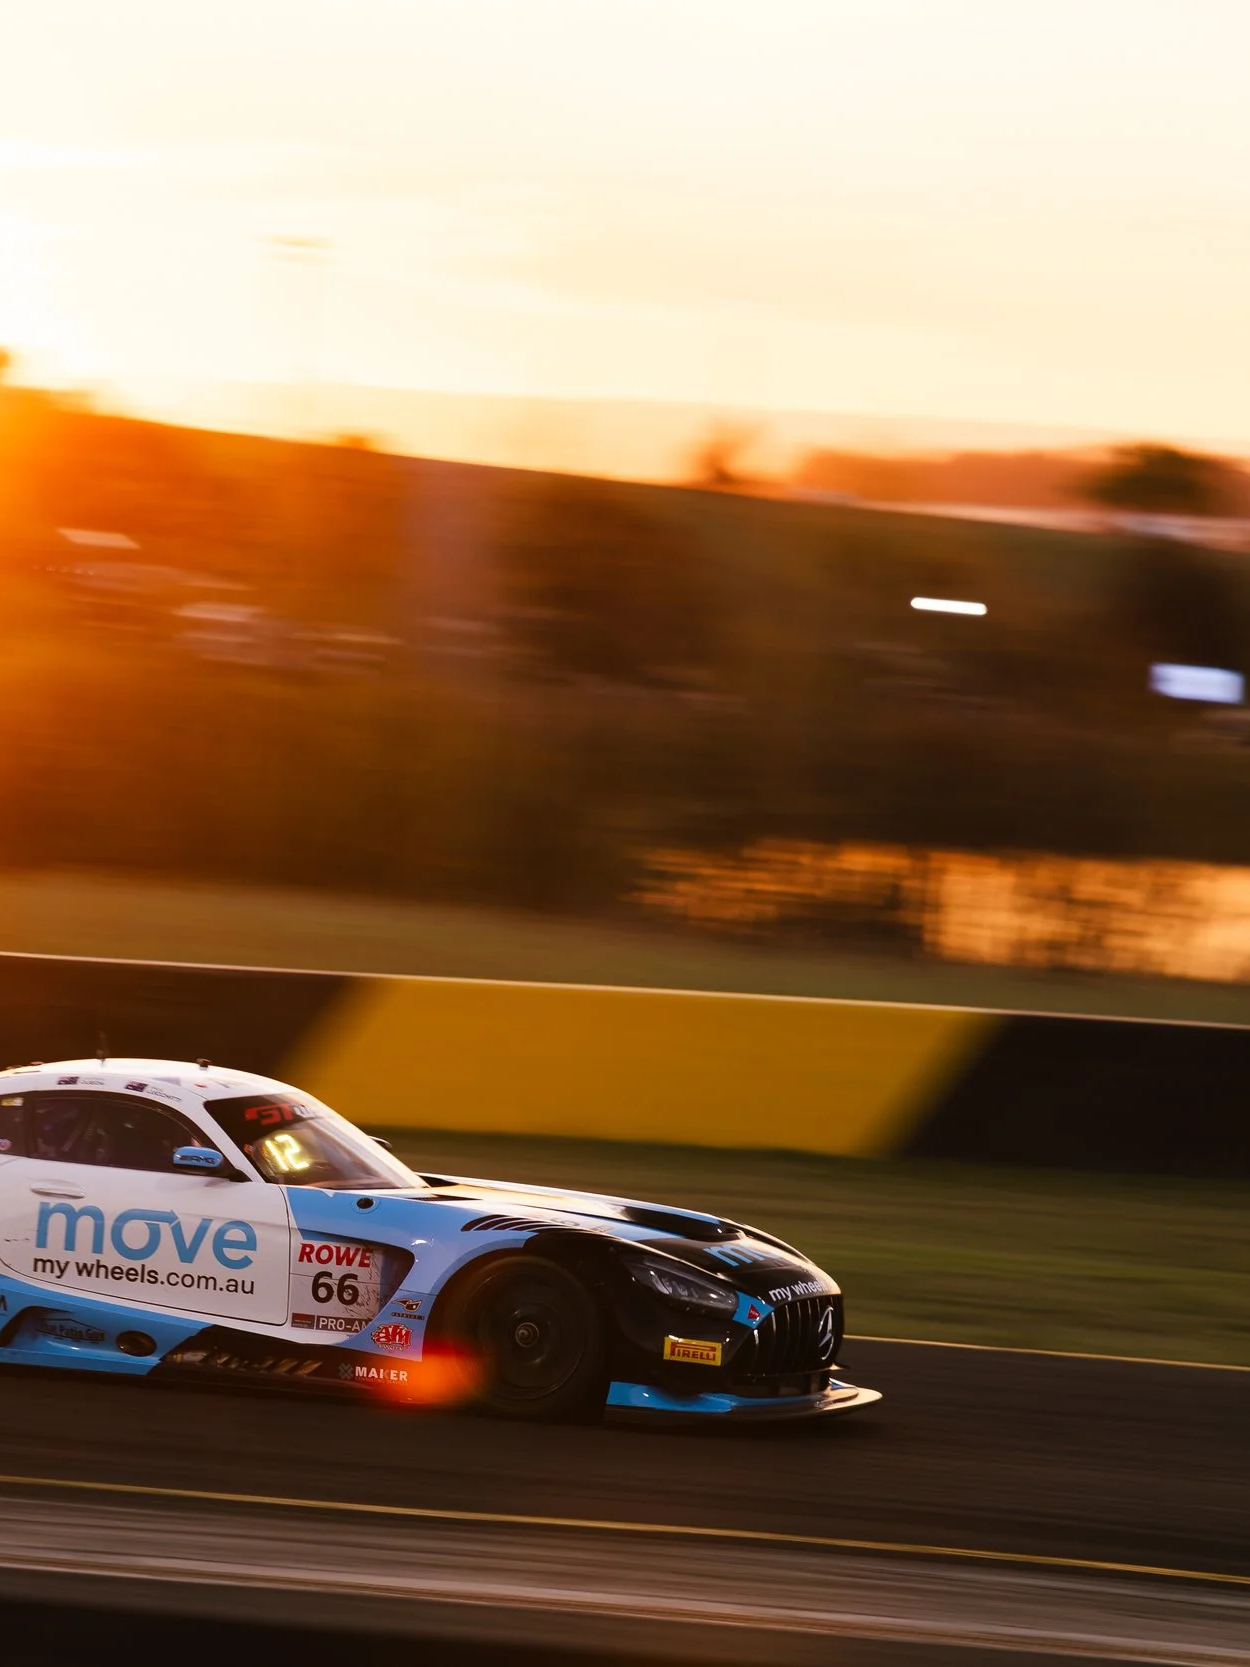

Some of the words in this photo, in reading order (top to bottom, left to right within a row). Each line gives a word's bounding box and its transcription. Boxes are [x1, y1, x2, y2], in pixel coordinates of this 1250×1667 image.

[263, 1133, 311, 1172] 12
[35, 1201, 258, 1270] move
[298, 1243, 374, 1268] ROWE
[33, 1257, 70, 1279] my
[75, 1259, 255, 1295] wheels.com.au
[311, 1270, 360, 1306] 66
[768, 1285, 792, 1302] my
[792, 1280, 829, 1297] wheel
[669, 1341, 717, 1361] PIRELLI
[355, 1366, 408, 1382] MAKER
